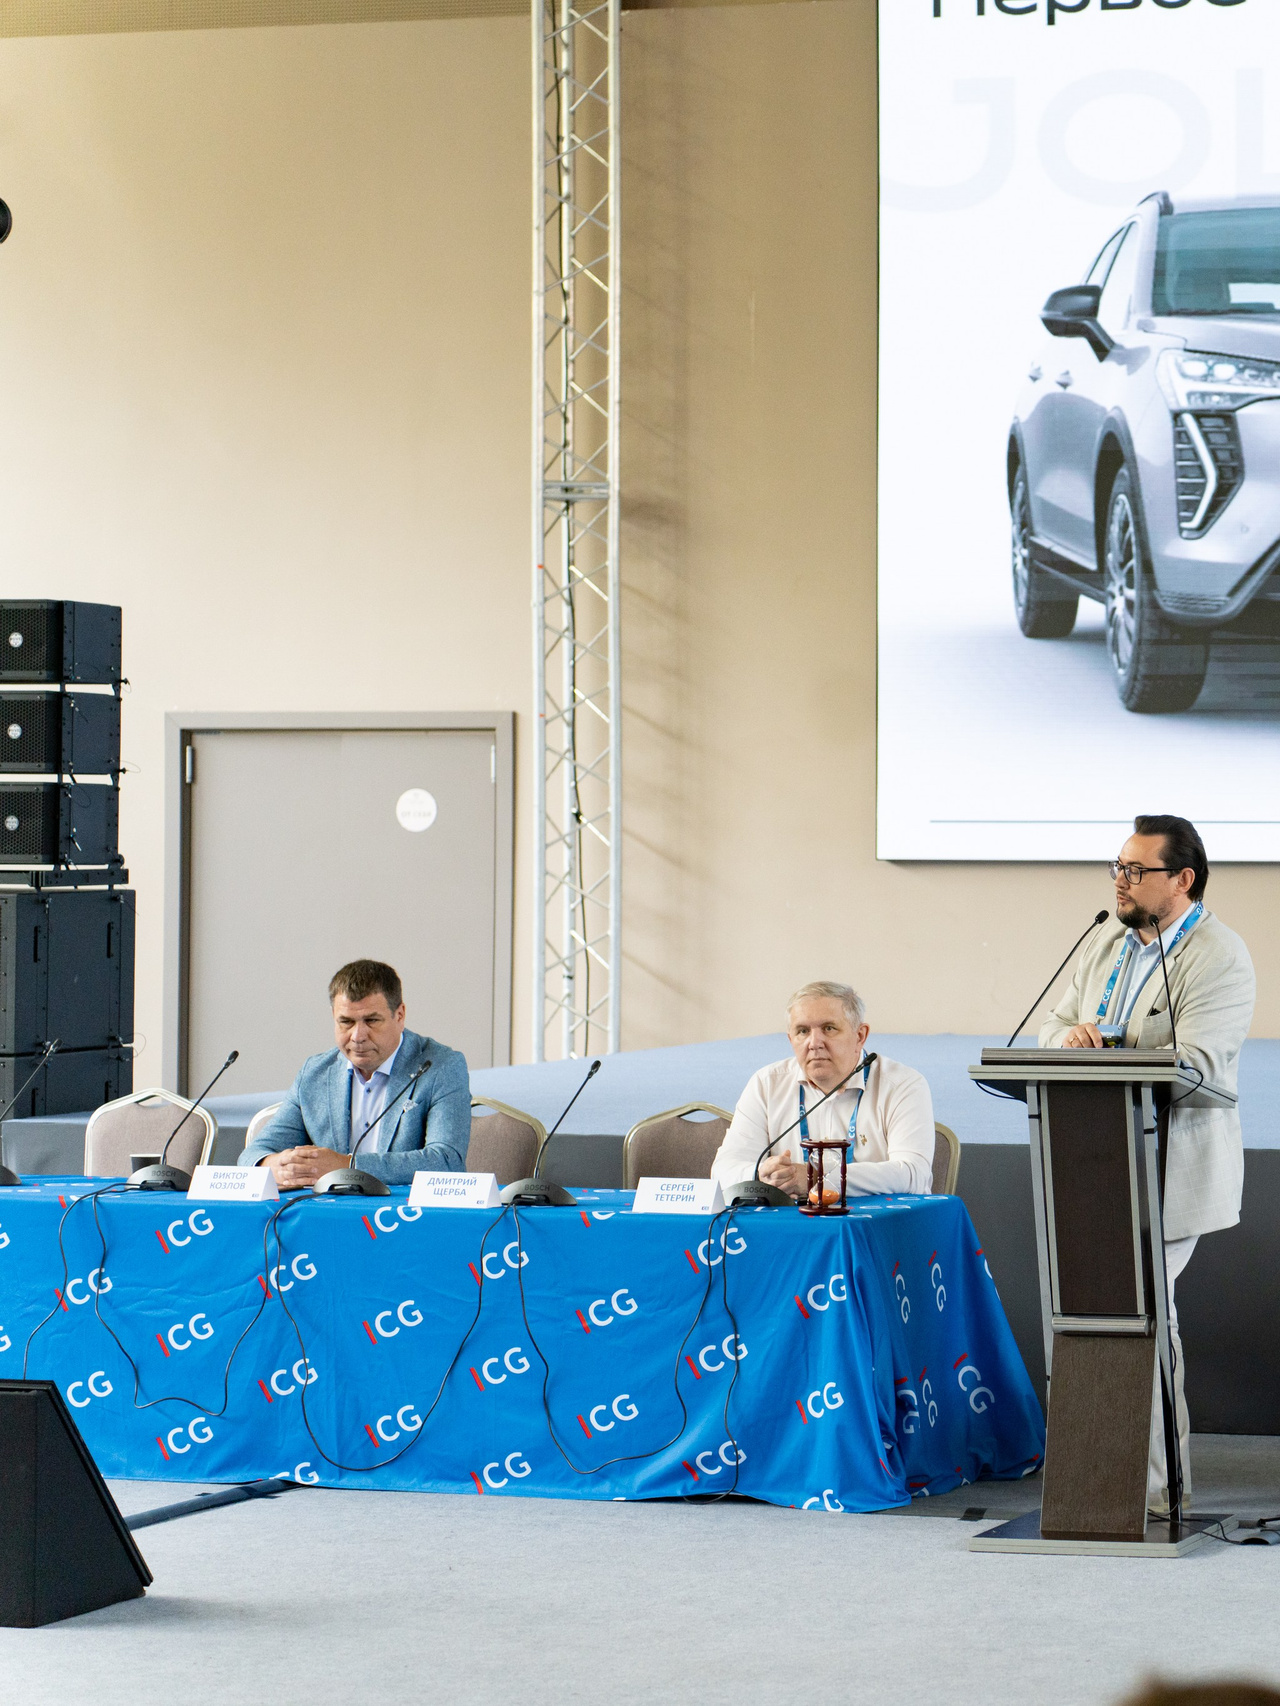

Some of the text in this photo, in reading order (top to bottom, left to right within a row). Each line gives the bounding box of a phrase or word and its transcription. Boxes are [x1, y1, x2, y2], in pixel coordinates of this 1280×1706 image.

[151, 1170, 176, 1178] BOSCH
[427, 1177, 477, 1186] ДМИТРИЙ
[433, 1188, 466, 1196] ЩЕРБА
[660, 1183, 694, 1191] СЕРГЕЙ
[744, 1186, 770, 1194] BOSCH
[155, 1209, 214, 1254] ICG
[685, 1227, 747, 1274] ICG
[257, 1254, 317, 1299] ICG
[469, 1240, 529, 1286] ICG
[928, 1250, 946, 1312] ICG
[54, 1268, 113, 1313] ICG
[576, 1289, 638, 1333] ICG
[794, 1274, 846, 1318] ICG
[892, 1261, 910, 1324] ICG
[156, 1313, 214, 1357] ICG
[363, 1300, 423, 1345] ICG
[470, 1347, 530, 1391] ICG
[686, 1334, 748, 1379] ICG
[67, 1371, 113, 1407] CG
[258, 1358, 318, 1403] ICG
[919, 1366, 938, 1428] ICG
[953, 1352, 995, 1414] ICG
[577, 1394, 638, 1438] ICG
[796, 1382, 844, 1424] ICG
[156, 1417, 213, 1460] ICG
[365, 1405, 422, 1448] ICG
[469, 1452, 531, 1496] ICG
[683, 1441, 746, 1481] ICG
